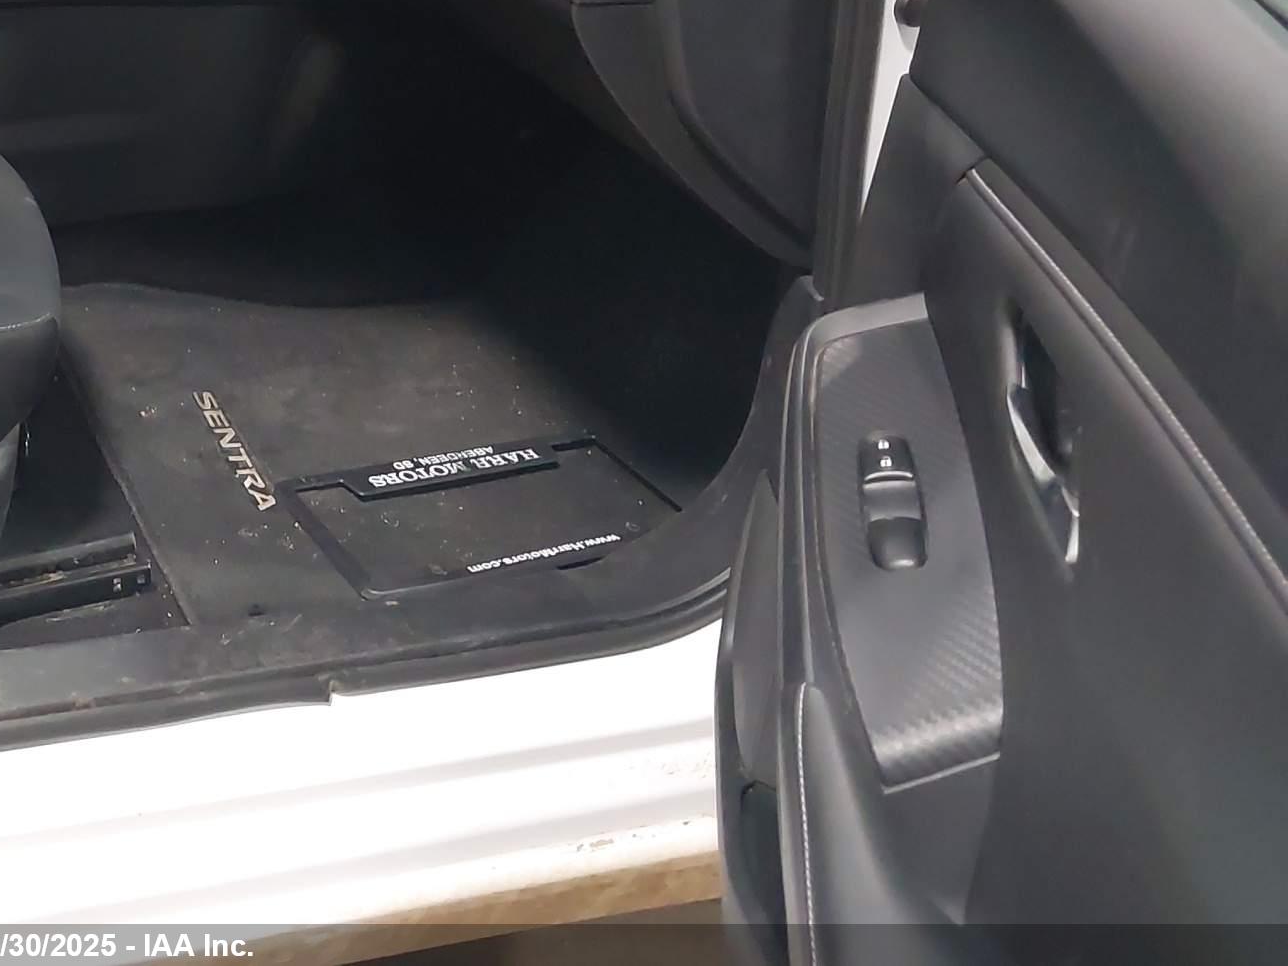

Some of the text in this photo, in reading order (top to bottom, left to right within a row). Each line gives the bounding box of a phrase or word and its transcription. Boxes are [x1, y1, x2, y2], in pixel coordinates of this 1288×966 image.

[193, 391, 276, 511] SENTRA
[368, 448, 541, 487] HARR MOTORS
[393, 460, 414, 470] SD
[467, 534, 621, 573] www.HarrMotors.com
